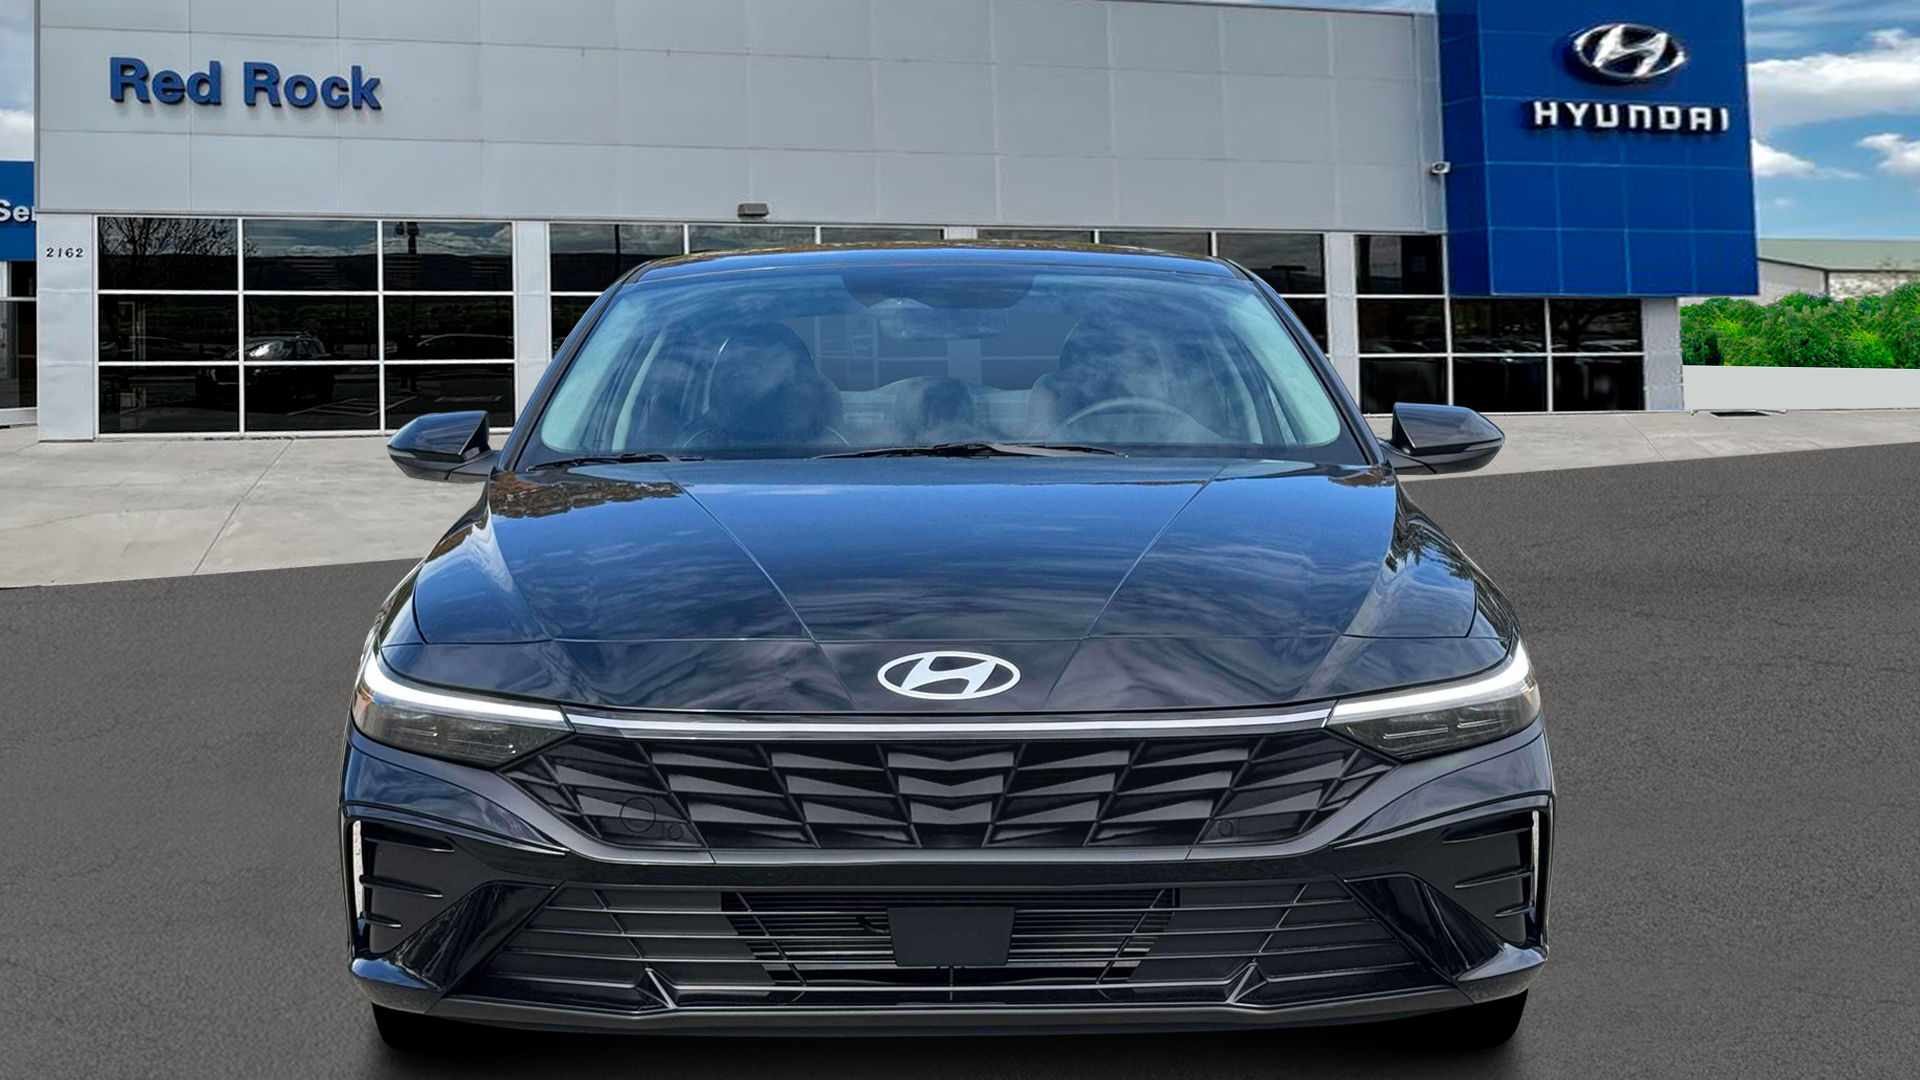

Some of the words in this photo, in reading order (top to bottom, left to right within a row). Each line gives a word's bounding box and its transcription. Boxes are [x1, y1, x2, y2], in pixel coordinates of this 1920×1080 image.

[110, 56, 222, 105] Red
[243, 61, 382, 111] Rock
[1533, 101, 1730, 132] HYUNDAI
[46, 247, 84, 258] 2162
